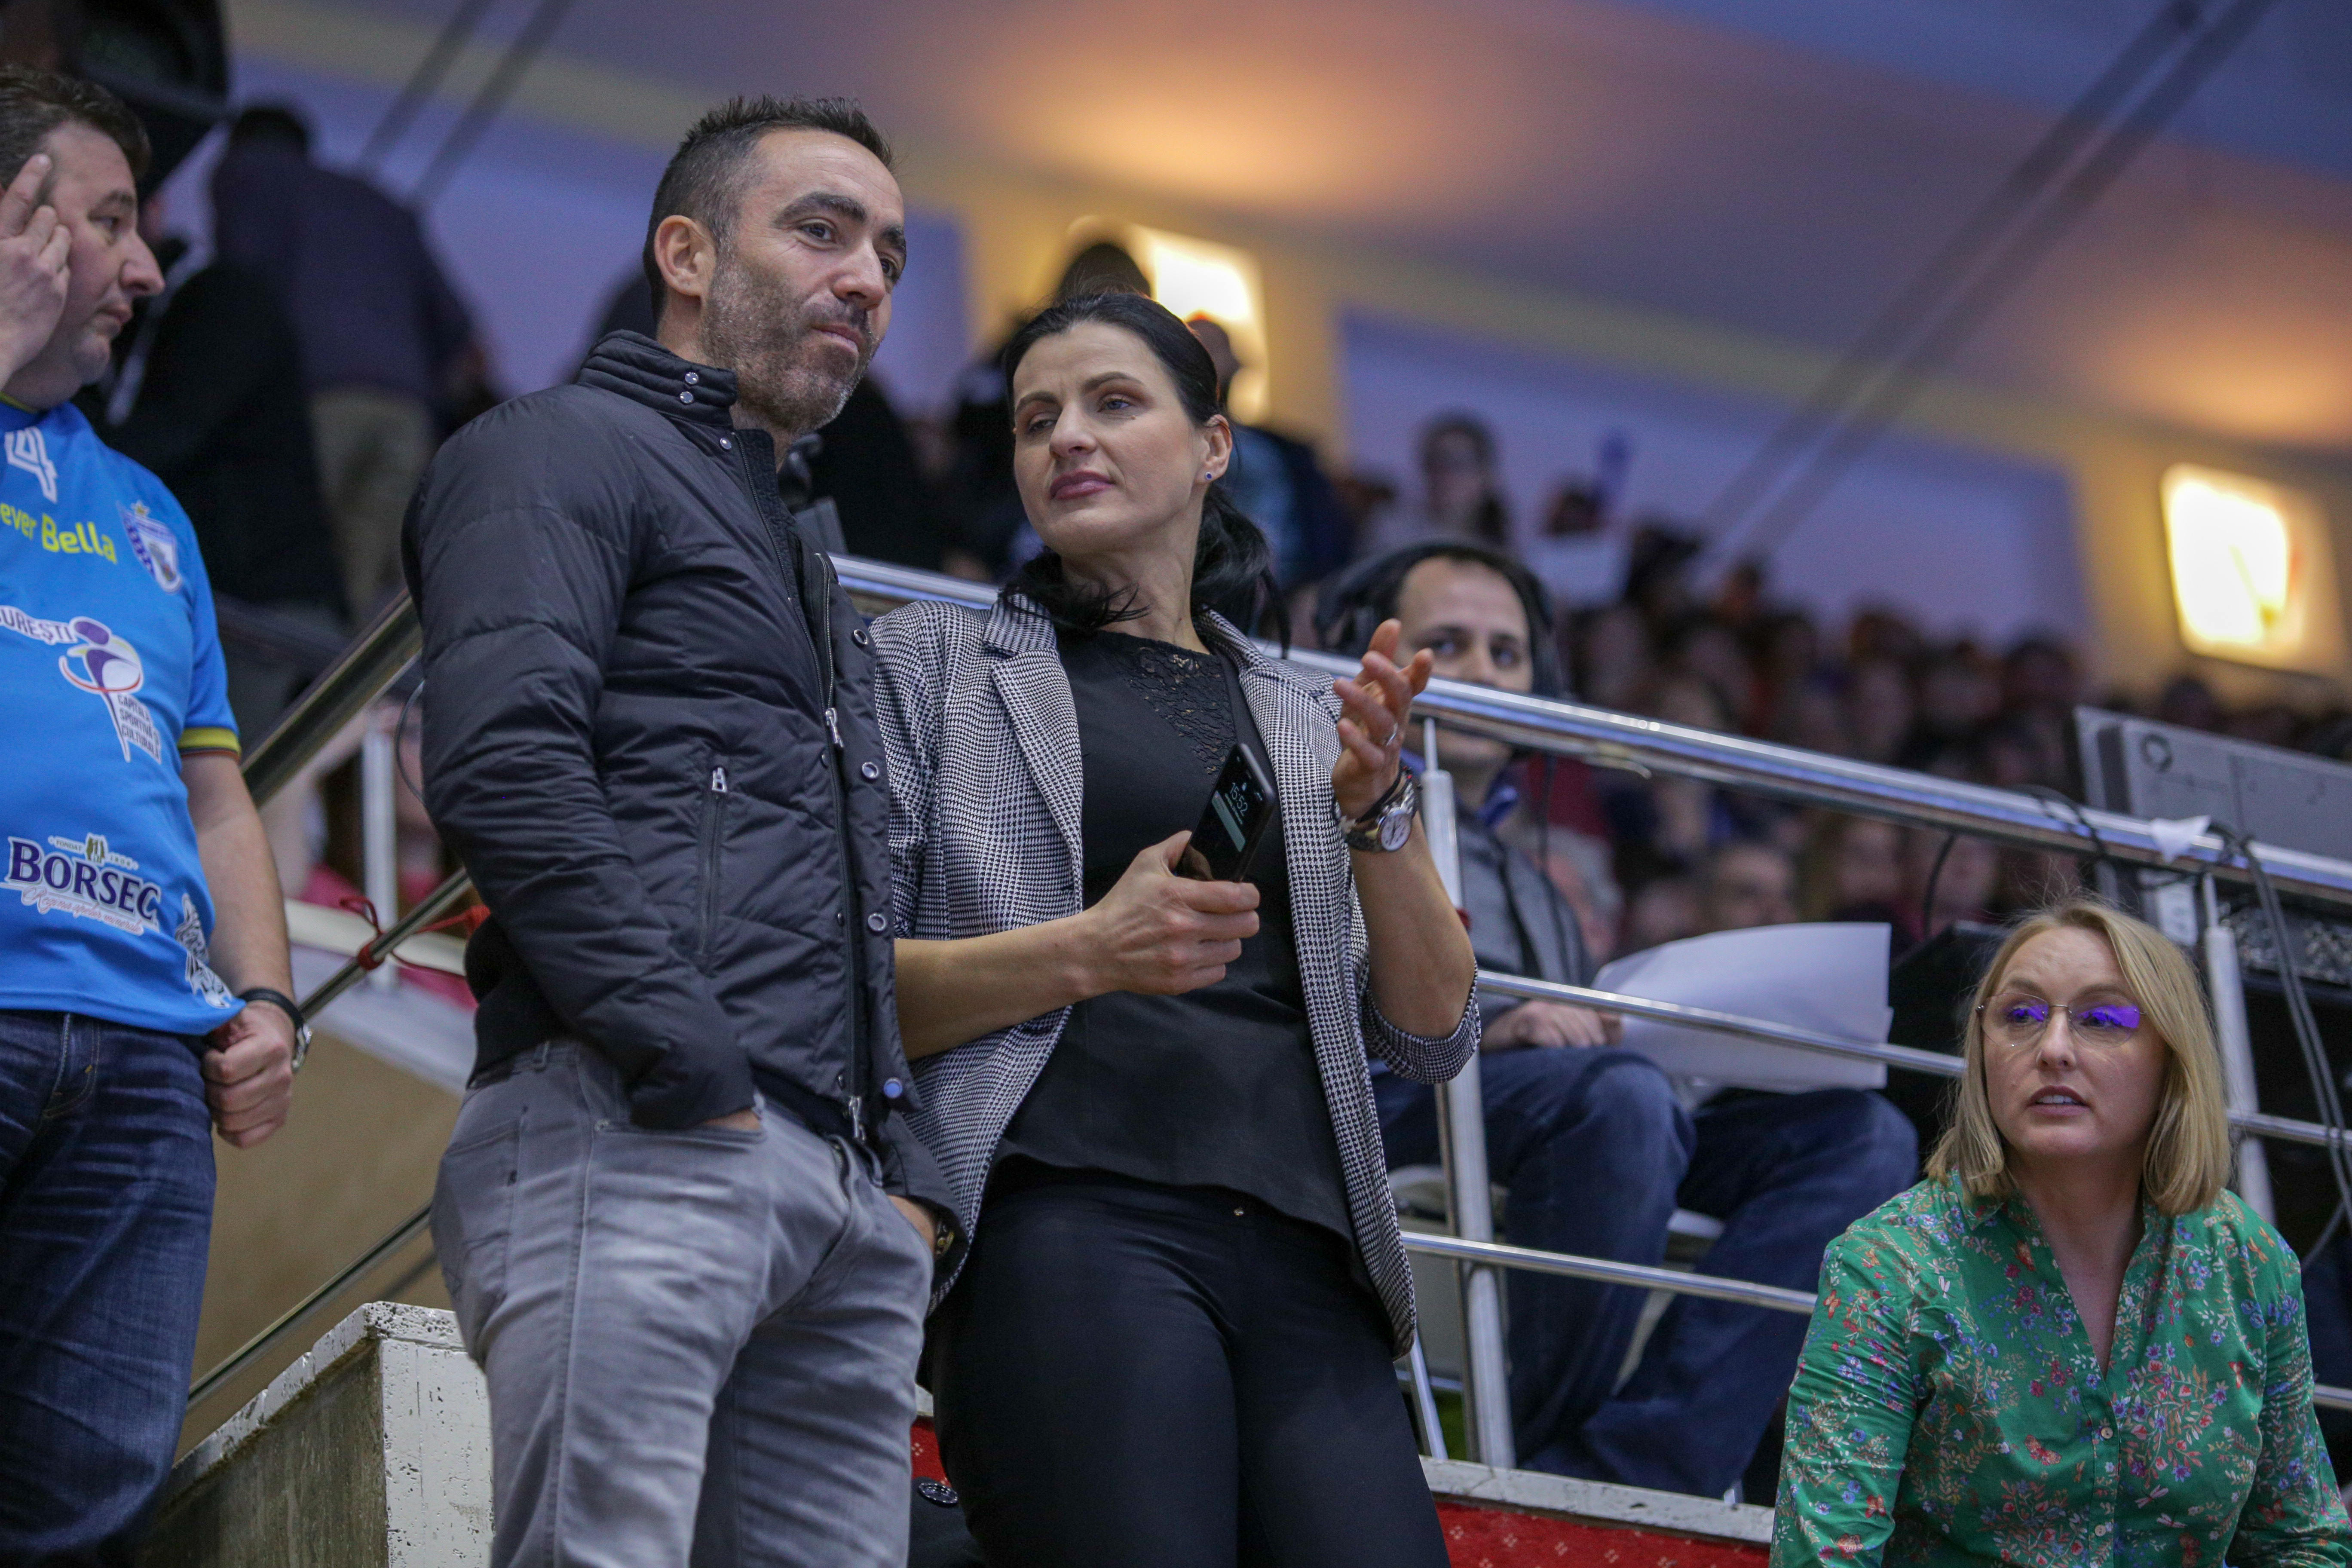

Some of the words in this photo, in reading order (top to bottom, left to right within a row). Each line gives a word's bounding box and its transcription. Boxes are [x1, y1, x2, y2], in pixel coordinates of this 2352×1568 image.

[42, 513, 117, 564] Bella
[0, 609, 73, 641] UREȘTI
[1229, 782, 1249, 817] 15:52
[56, 840, 83, 851] FONDAT
[9, 840, 158, 920] BORSEC
